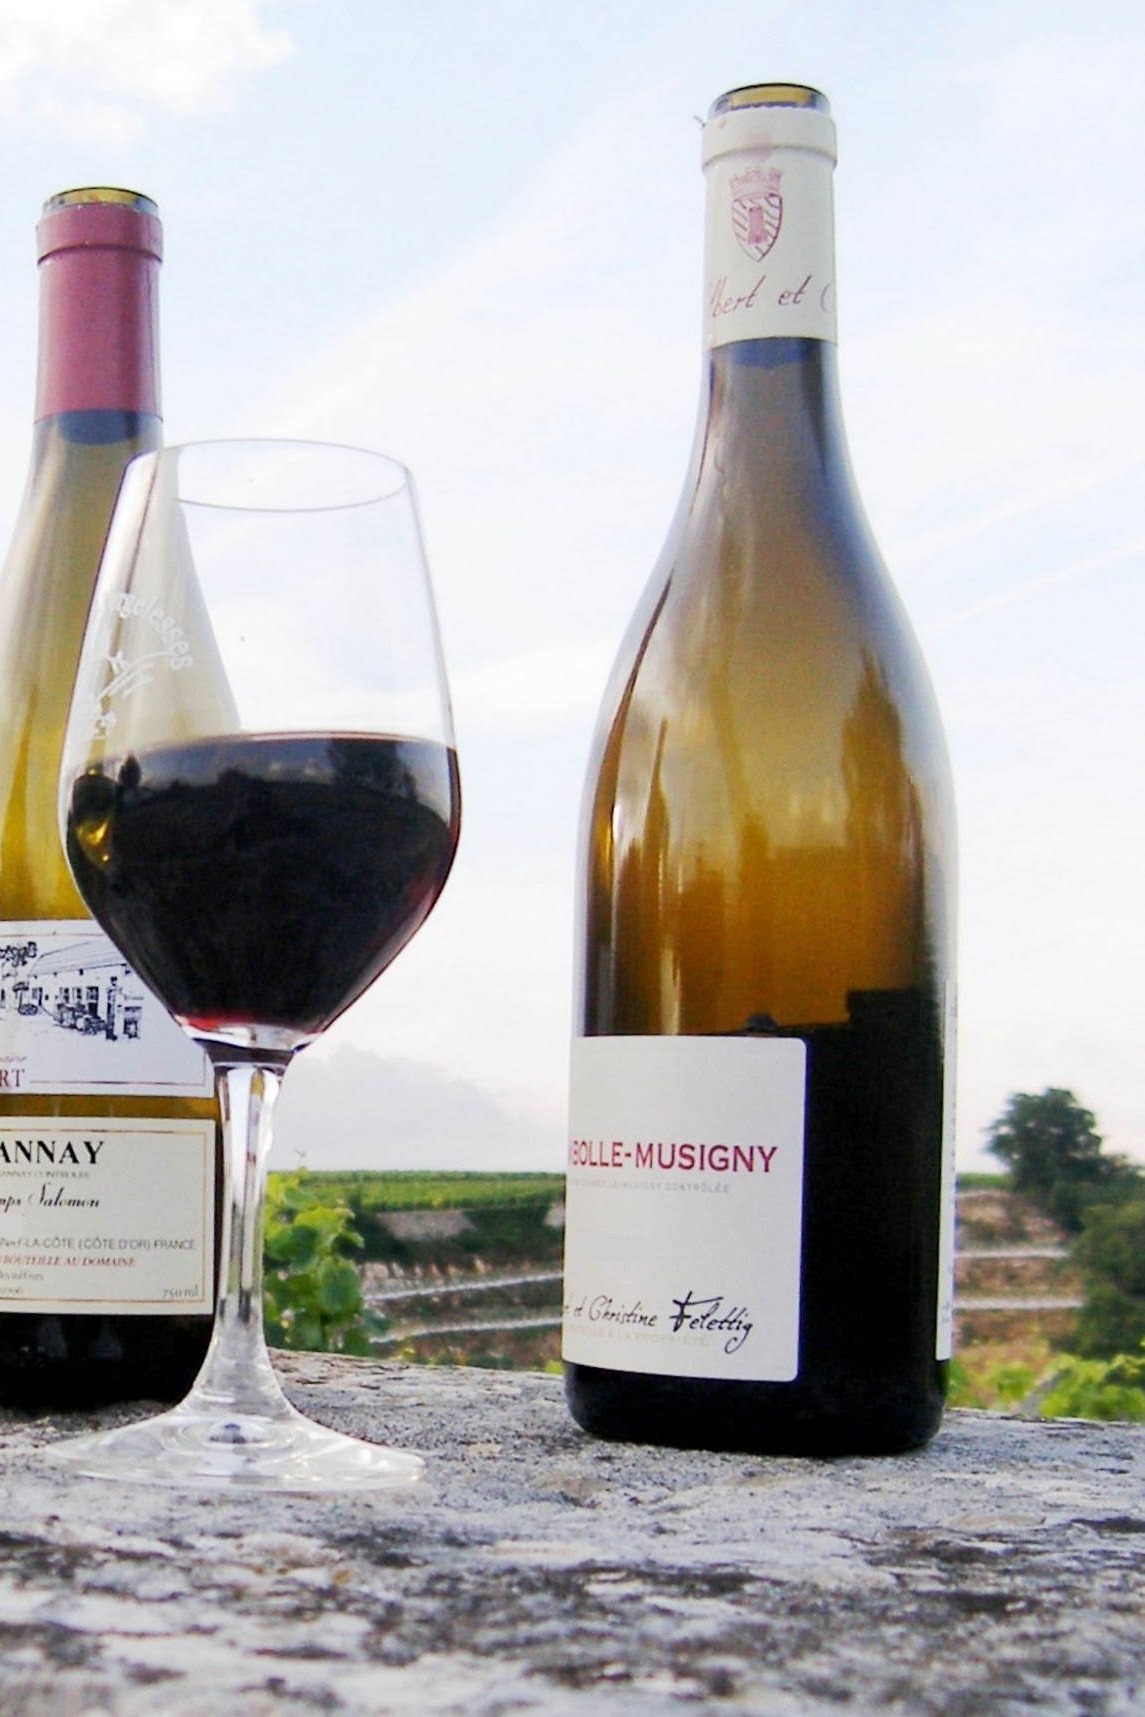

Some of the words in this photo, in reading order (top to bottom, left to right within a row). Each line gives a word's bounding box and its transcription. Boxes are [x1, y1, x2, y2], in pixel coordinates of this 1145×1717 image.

[777, 274, 813, 306] et
[28, 1181, 100, 1207] Salomon
[665, 1182, 731, 1195] CONTRÔLÉE
[77, 1236, 115, 1251] (CÔTE
[154, 1238, 196, 1251] FRANCE
[2, 1255, 61, 1267] BOUTEILLE
[81, 1257, 136, 1268] DOMAINE
[161, 1287, 182, 1299] 750
[183, 1282, 199, 1298] ml
[588, 1295, 658, 1327] Christine
[669, 1290, 753, 1354] Felettig
